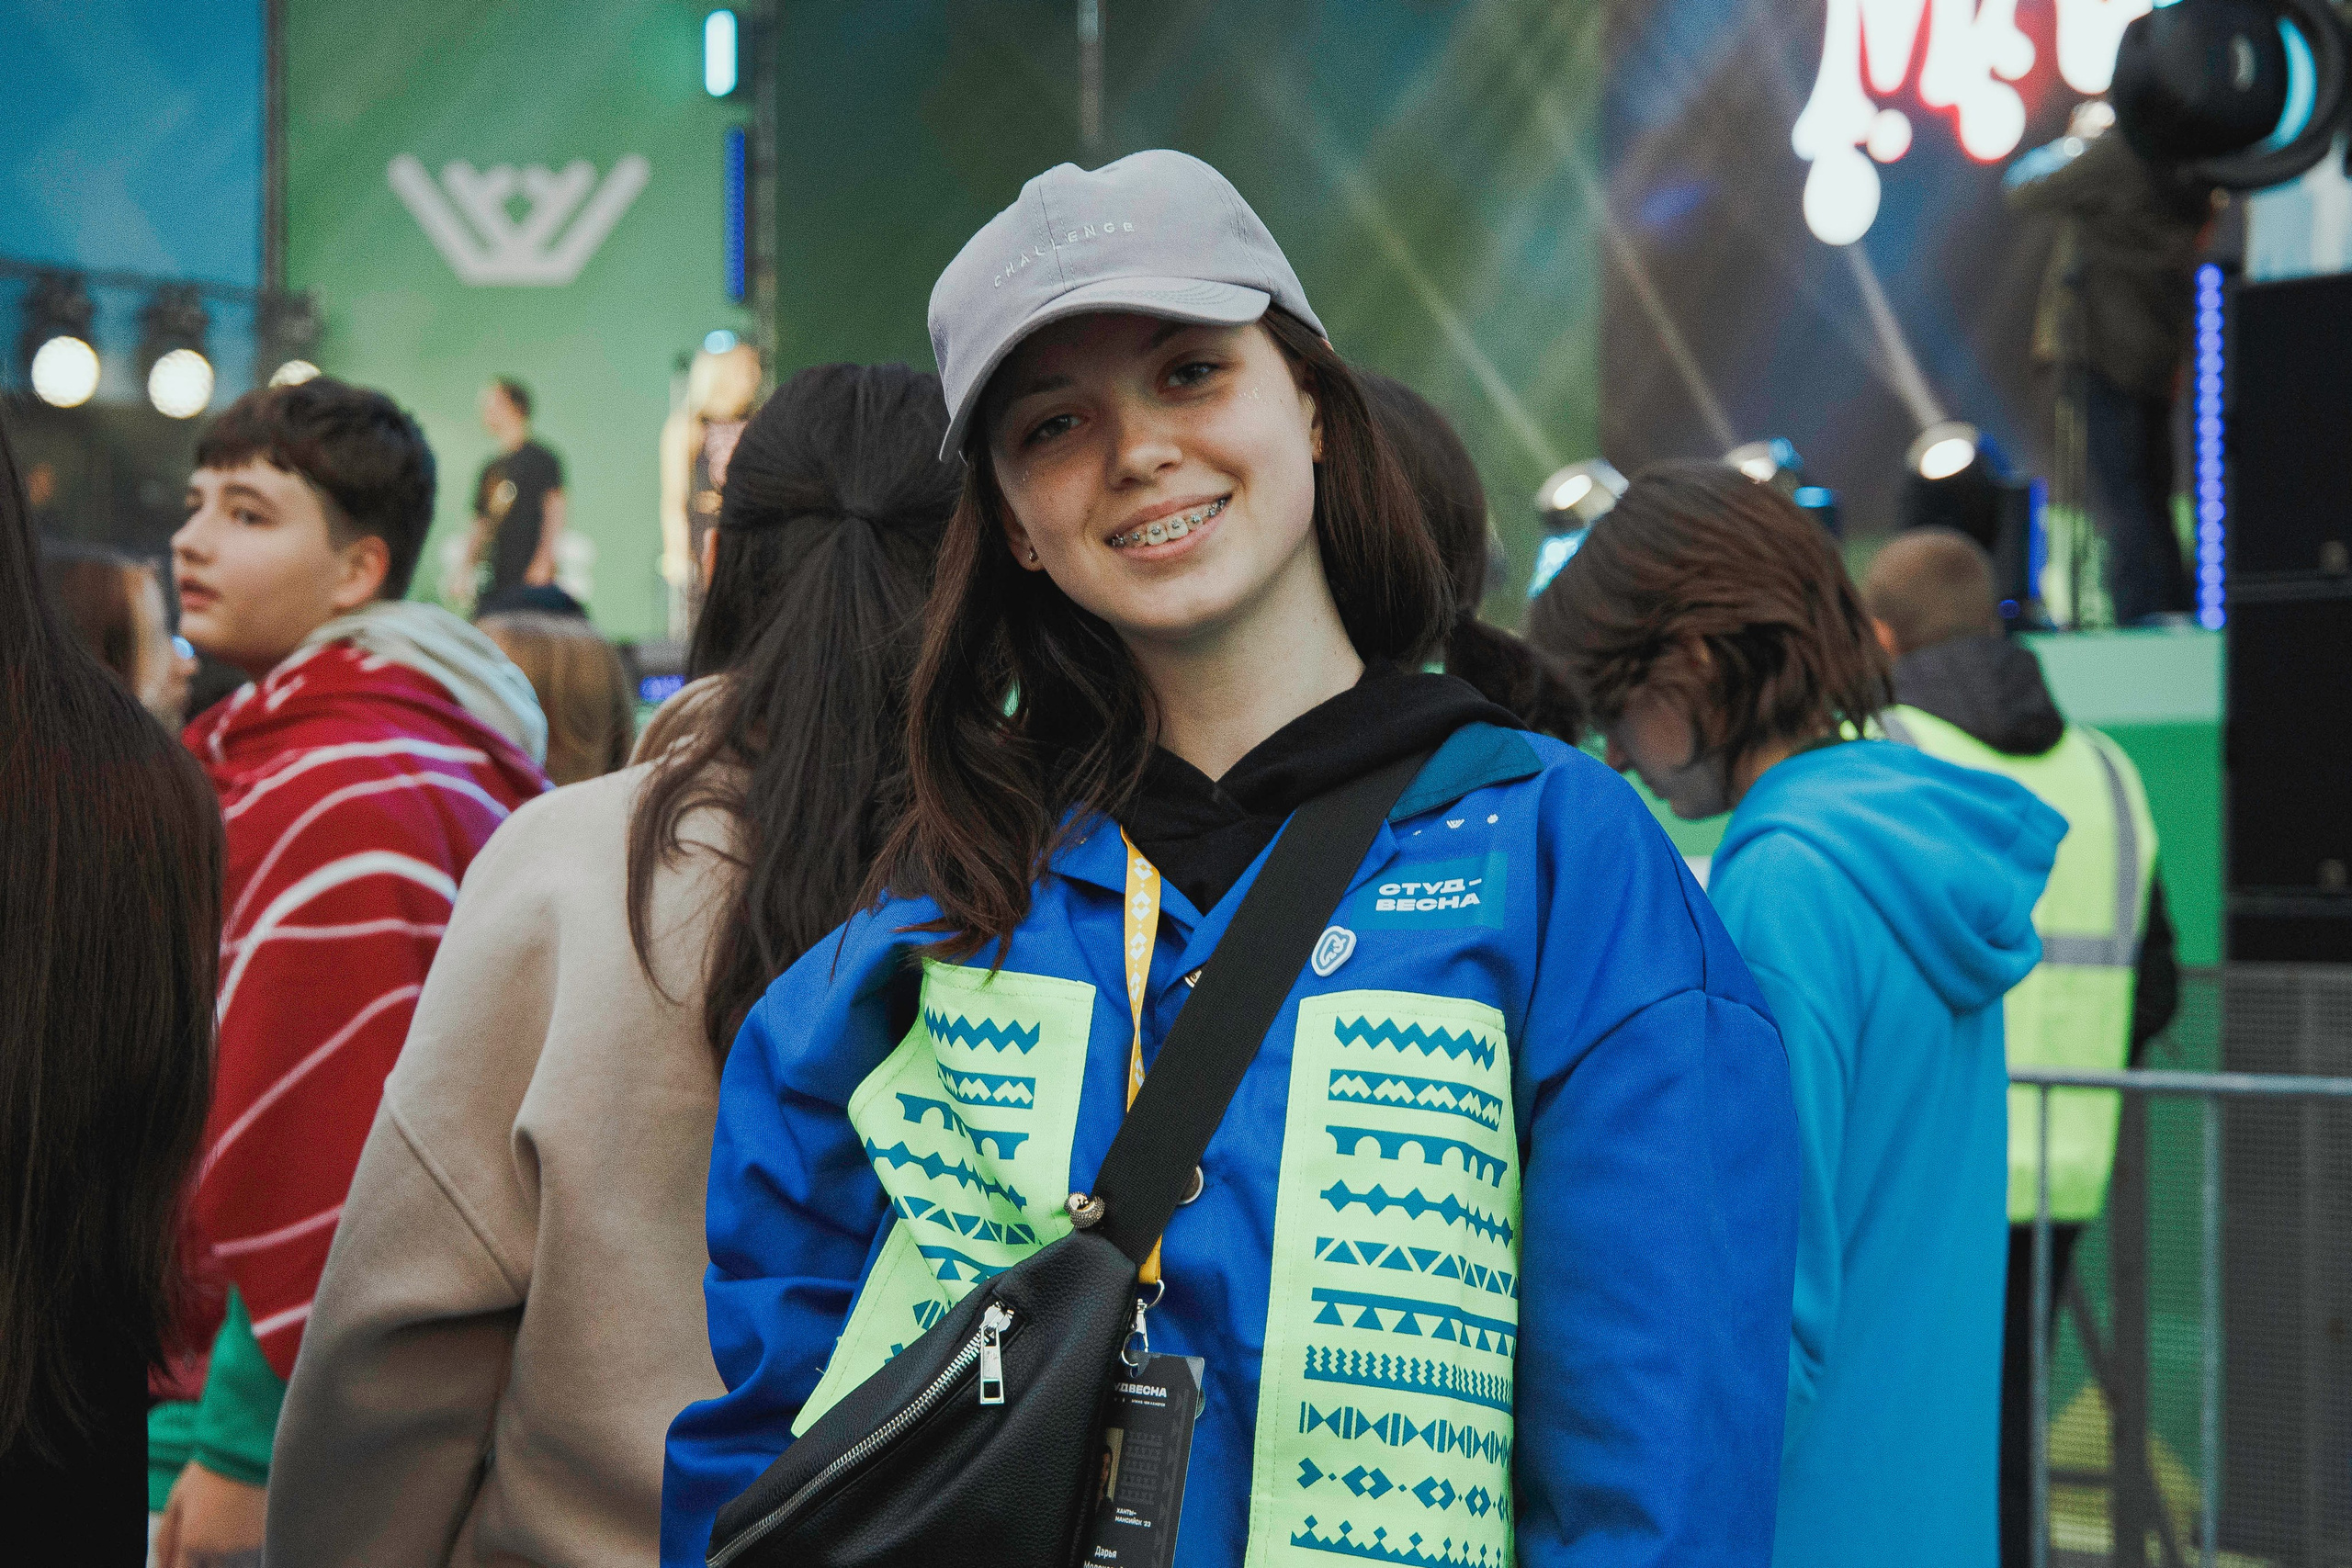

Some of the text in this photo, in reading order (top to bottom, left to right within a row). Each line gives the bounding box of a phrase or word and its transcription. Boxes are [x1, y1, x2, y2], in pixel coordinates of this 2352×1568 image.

[993, 221, 1135, 288] CHALLENGE
[1379, 878, 1481, 896] СТУД-
[1375, 892, 1480, 912] ВЕСНА
[1094, 1545, 1117, 1559] Дарья
